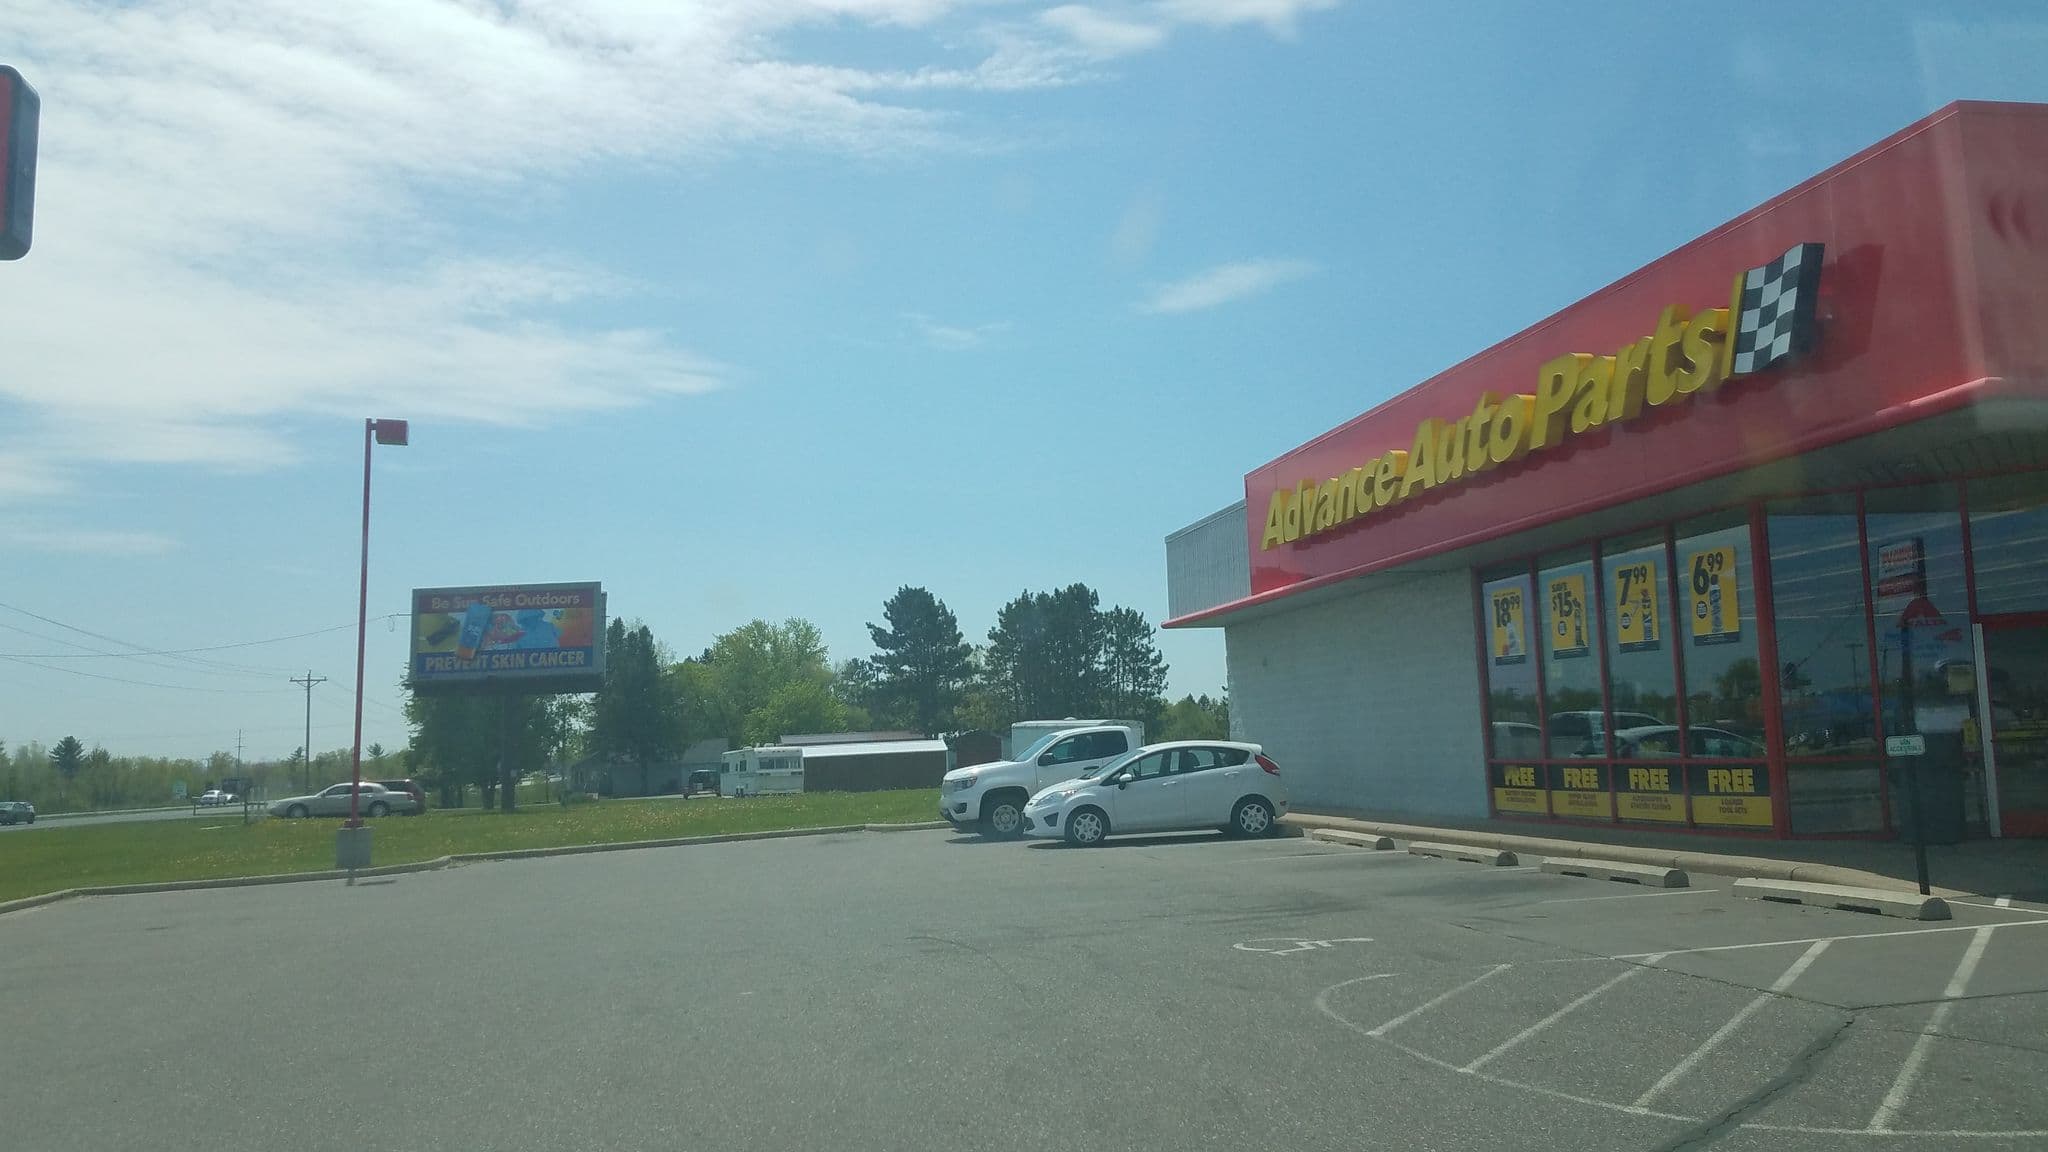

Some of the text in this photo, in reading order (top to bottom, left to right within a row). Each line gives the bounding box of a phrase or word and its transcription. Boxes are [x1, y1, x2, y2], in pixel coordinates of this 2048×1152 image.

[1261, 304, 1728, 550] Advance Auto Parts
[431, 597, 449, 609] Be
[482, 594, 510, 608] Safe
[515, 592, 580, 606] Outdoors
[425, 651, 585, 672] PREVENT SKIN CANCER
[1504, 766, 1535, 786] FREE
[1563, 768, 1599, 789] FREE
[1628, 768, 1669, 791] FREE
[1707, 769, 1755, 792] FREE
